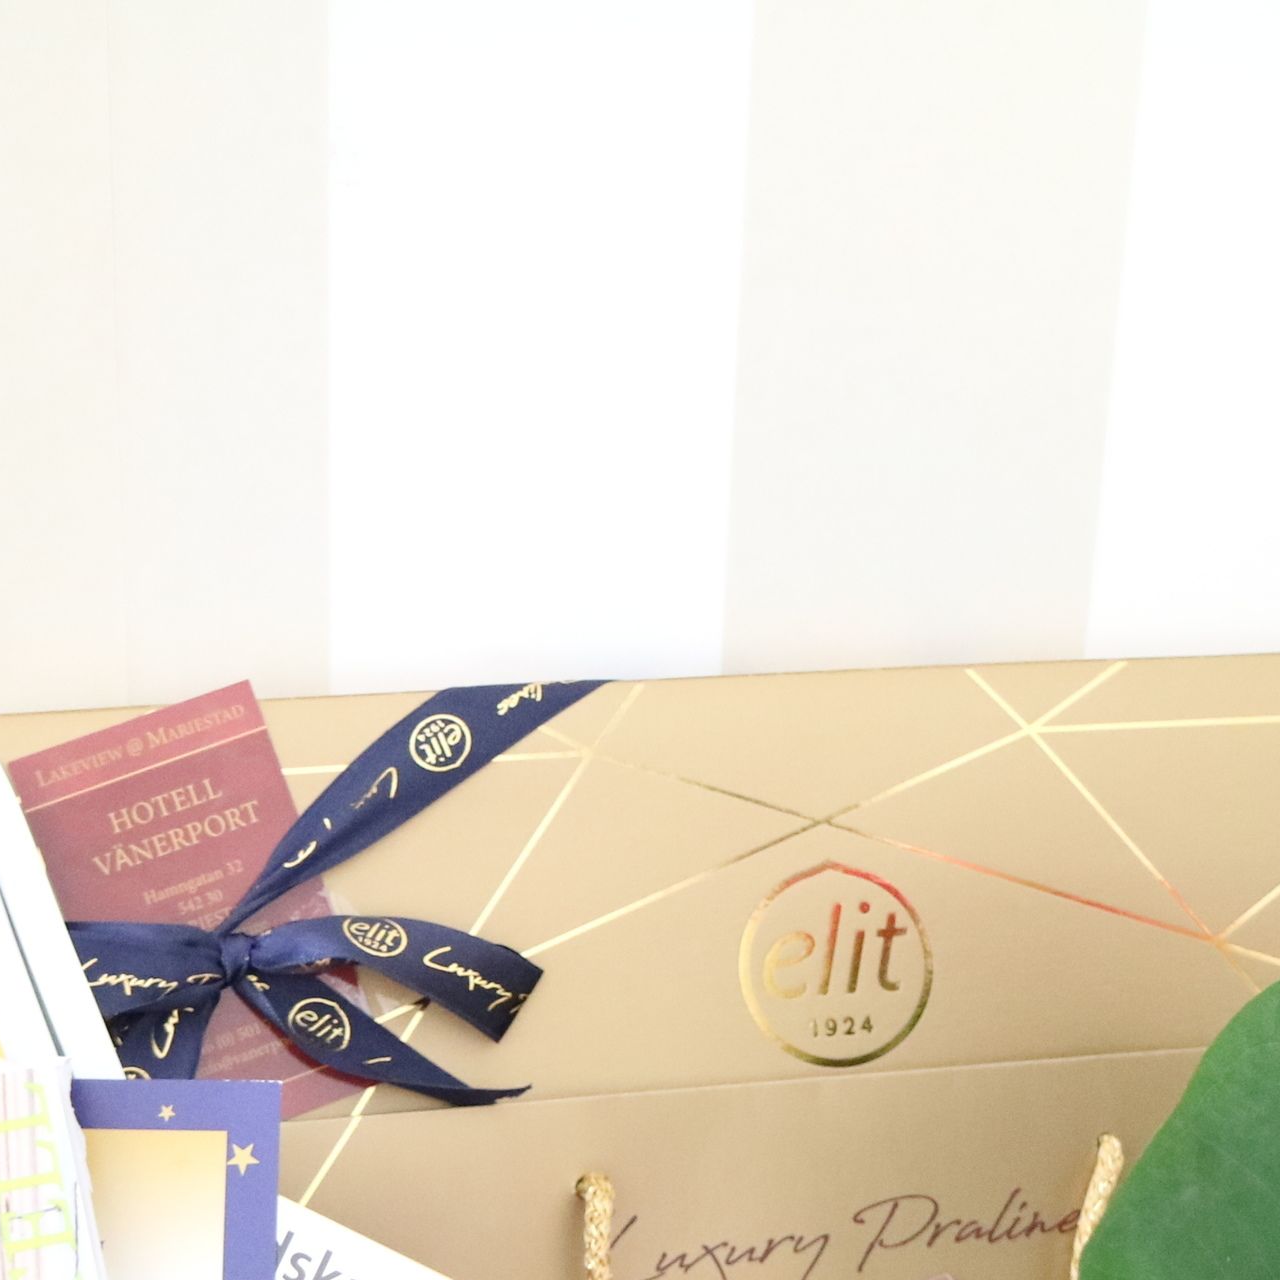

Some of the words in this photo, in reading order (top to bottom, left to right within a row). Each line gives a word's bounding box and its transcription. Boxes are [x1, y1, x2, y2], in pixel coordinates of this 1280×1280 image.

[108, 778, 222, 833] HOTELL
[92, 801, 259, 876] VÄNERPORT
[347, 920, 400, 946] elit
[764, 902, 907, 998] elit
[423, 947, 513, 1009] Luxury
[294, 1010, 343, 1039] elit
[810, 1016, 873, 1037] 1924
